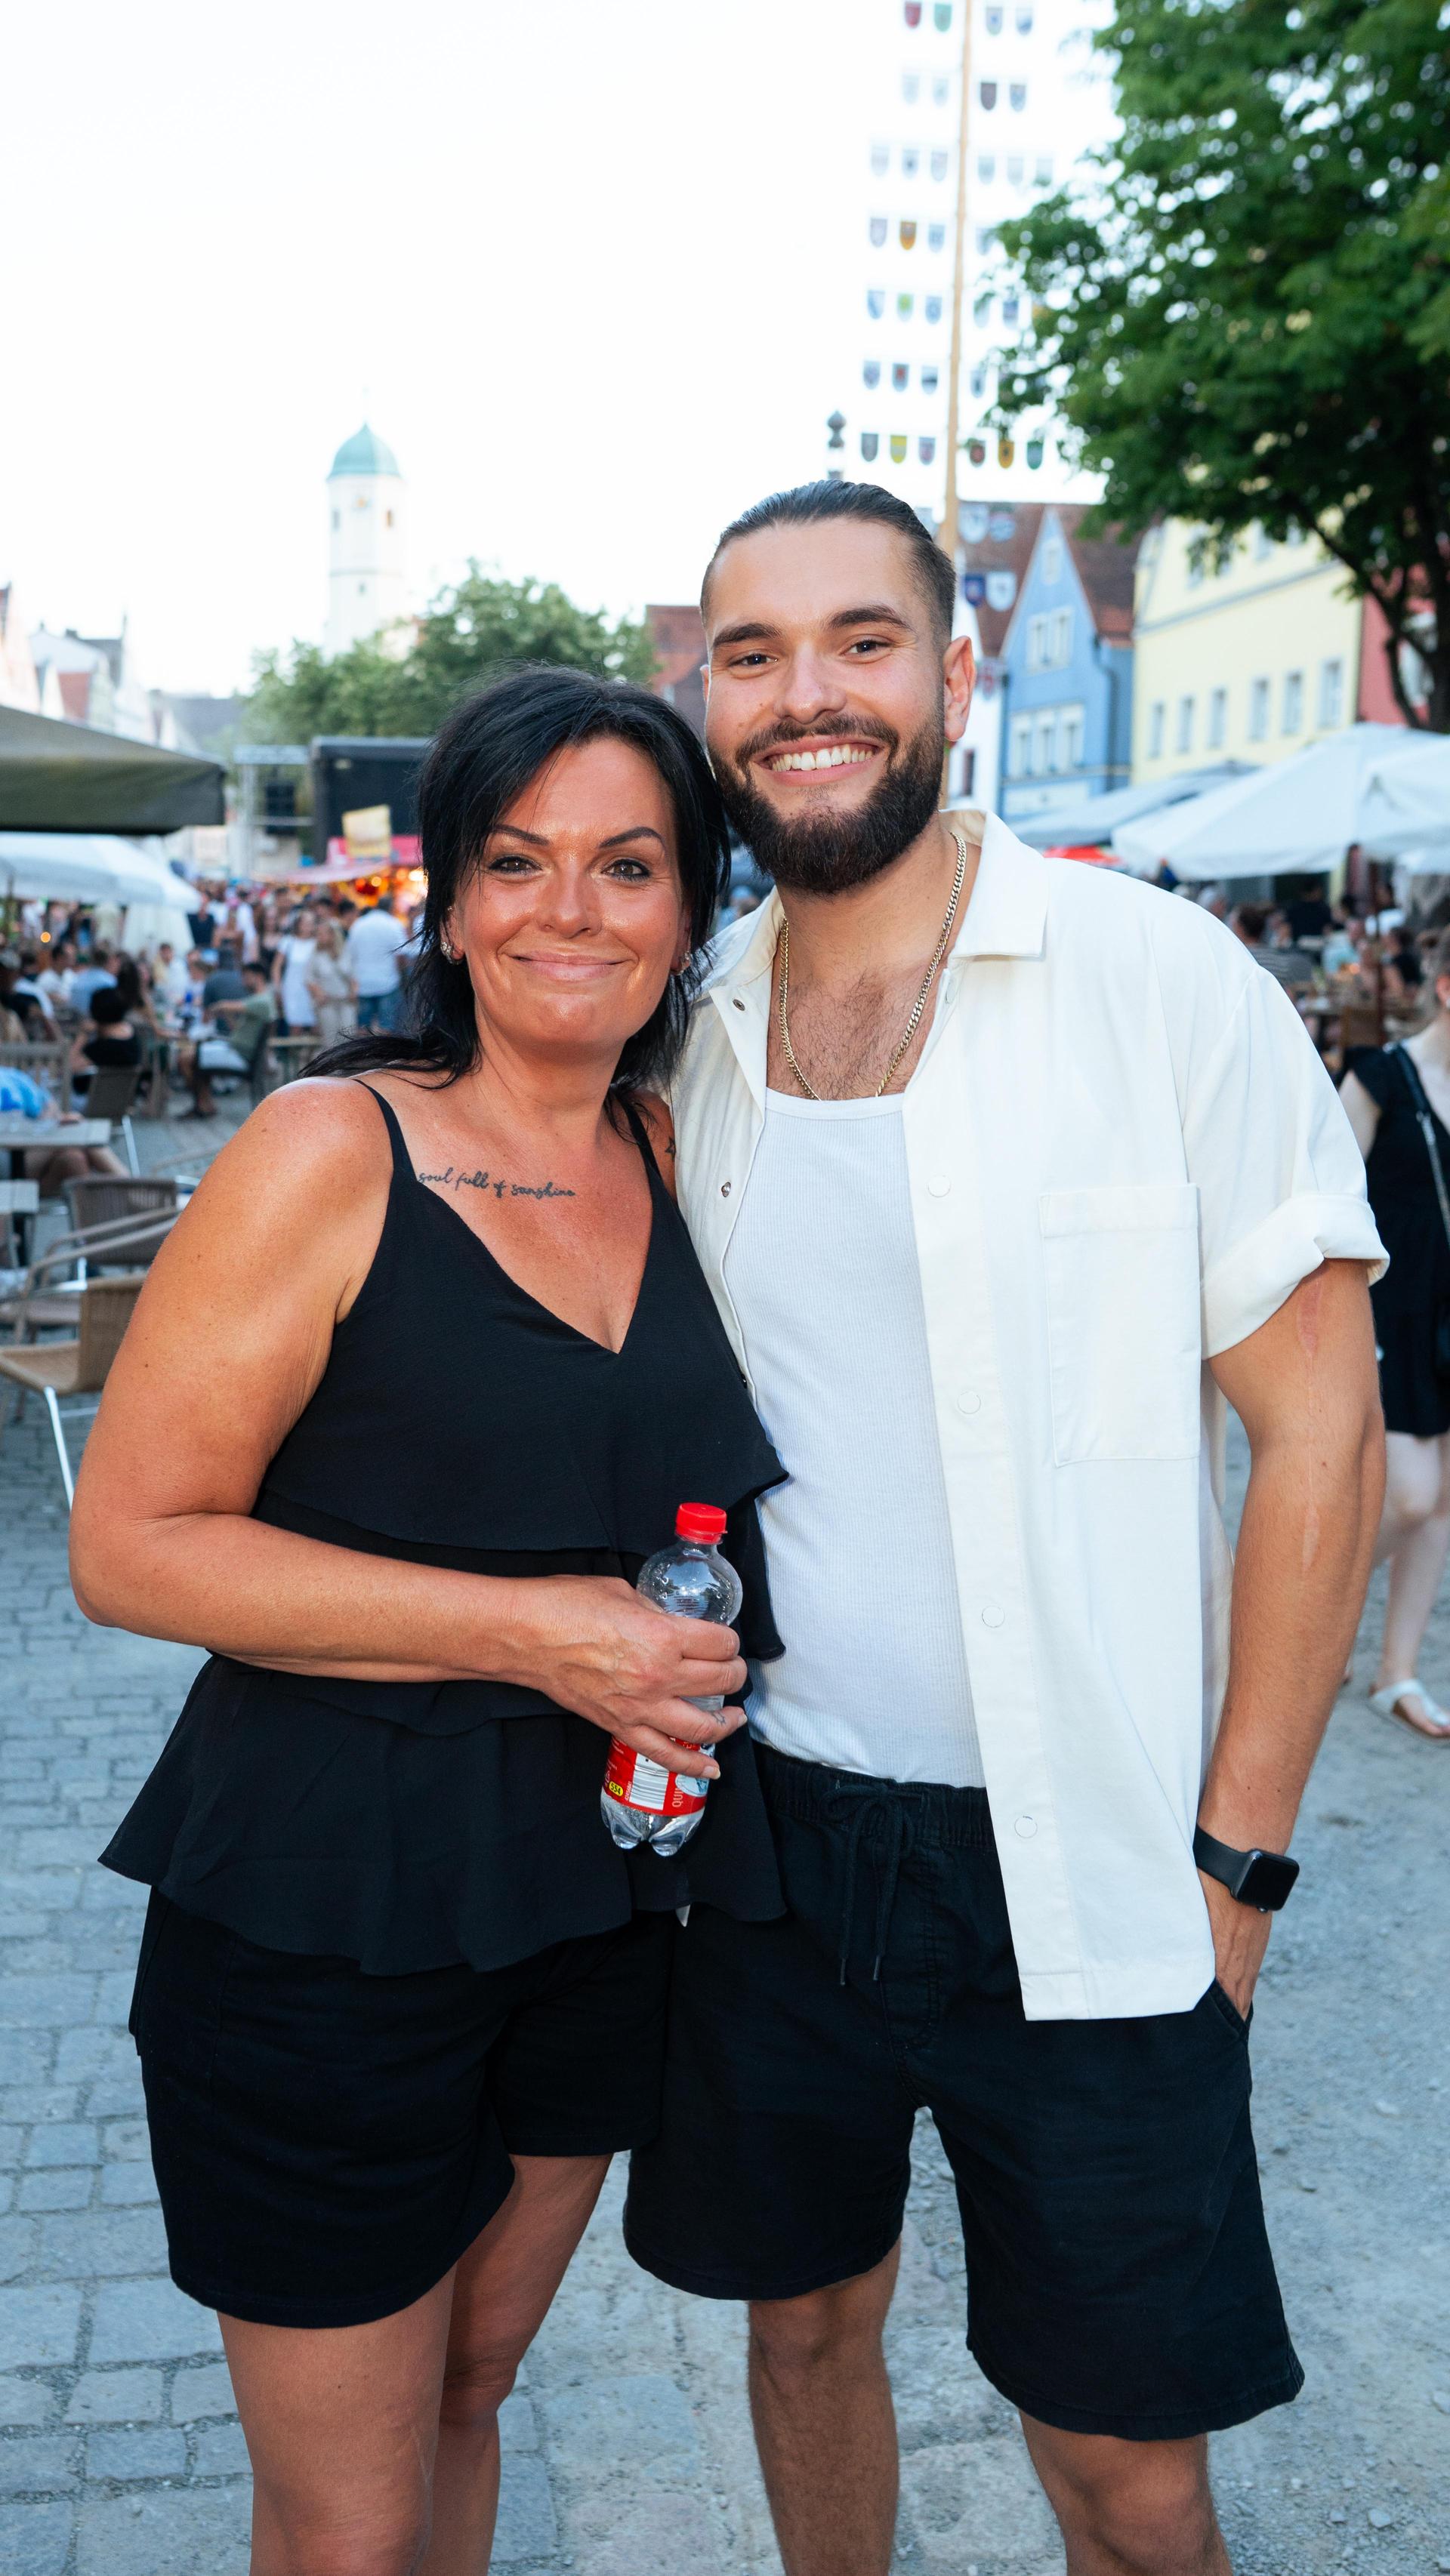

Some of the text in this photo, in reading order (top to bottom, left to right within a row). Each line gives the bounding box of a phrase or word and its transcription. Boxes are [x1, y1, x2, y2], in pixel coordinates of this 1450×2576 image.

[418, 1167, 453, 1183] soul
[455, 1171, 489, 1191] full
[511, 1182, 575, 1200] sunshine
[610, 1783, 621, 1795] 554
